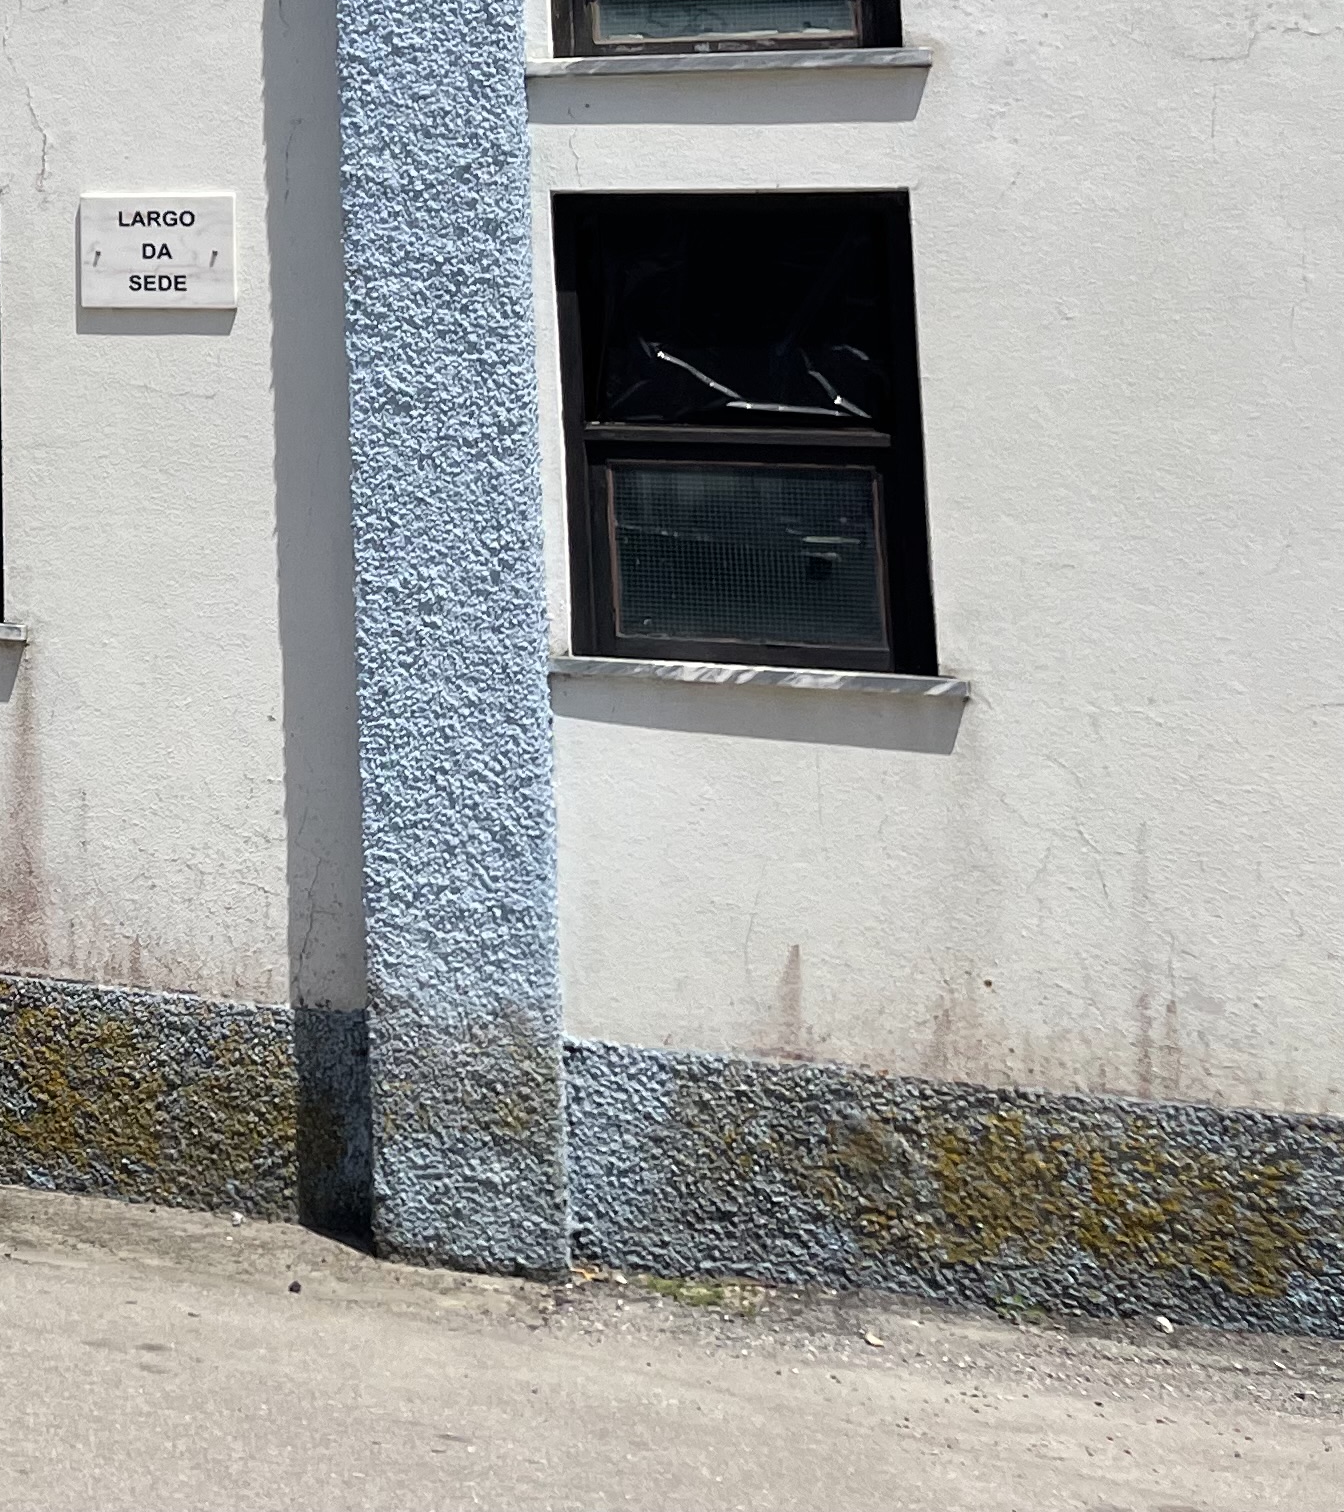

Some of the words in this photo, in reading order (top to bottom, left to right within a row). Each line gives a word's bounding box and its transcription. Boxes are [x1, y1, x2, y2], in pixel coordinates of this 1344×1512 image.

[118, 210, 196, 227] LARGO
[142, 243, 173, 260] DA
[128, 274, 187, 292] SEDE
